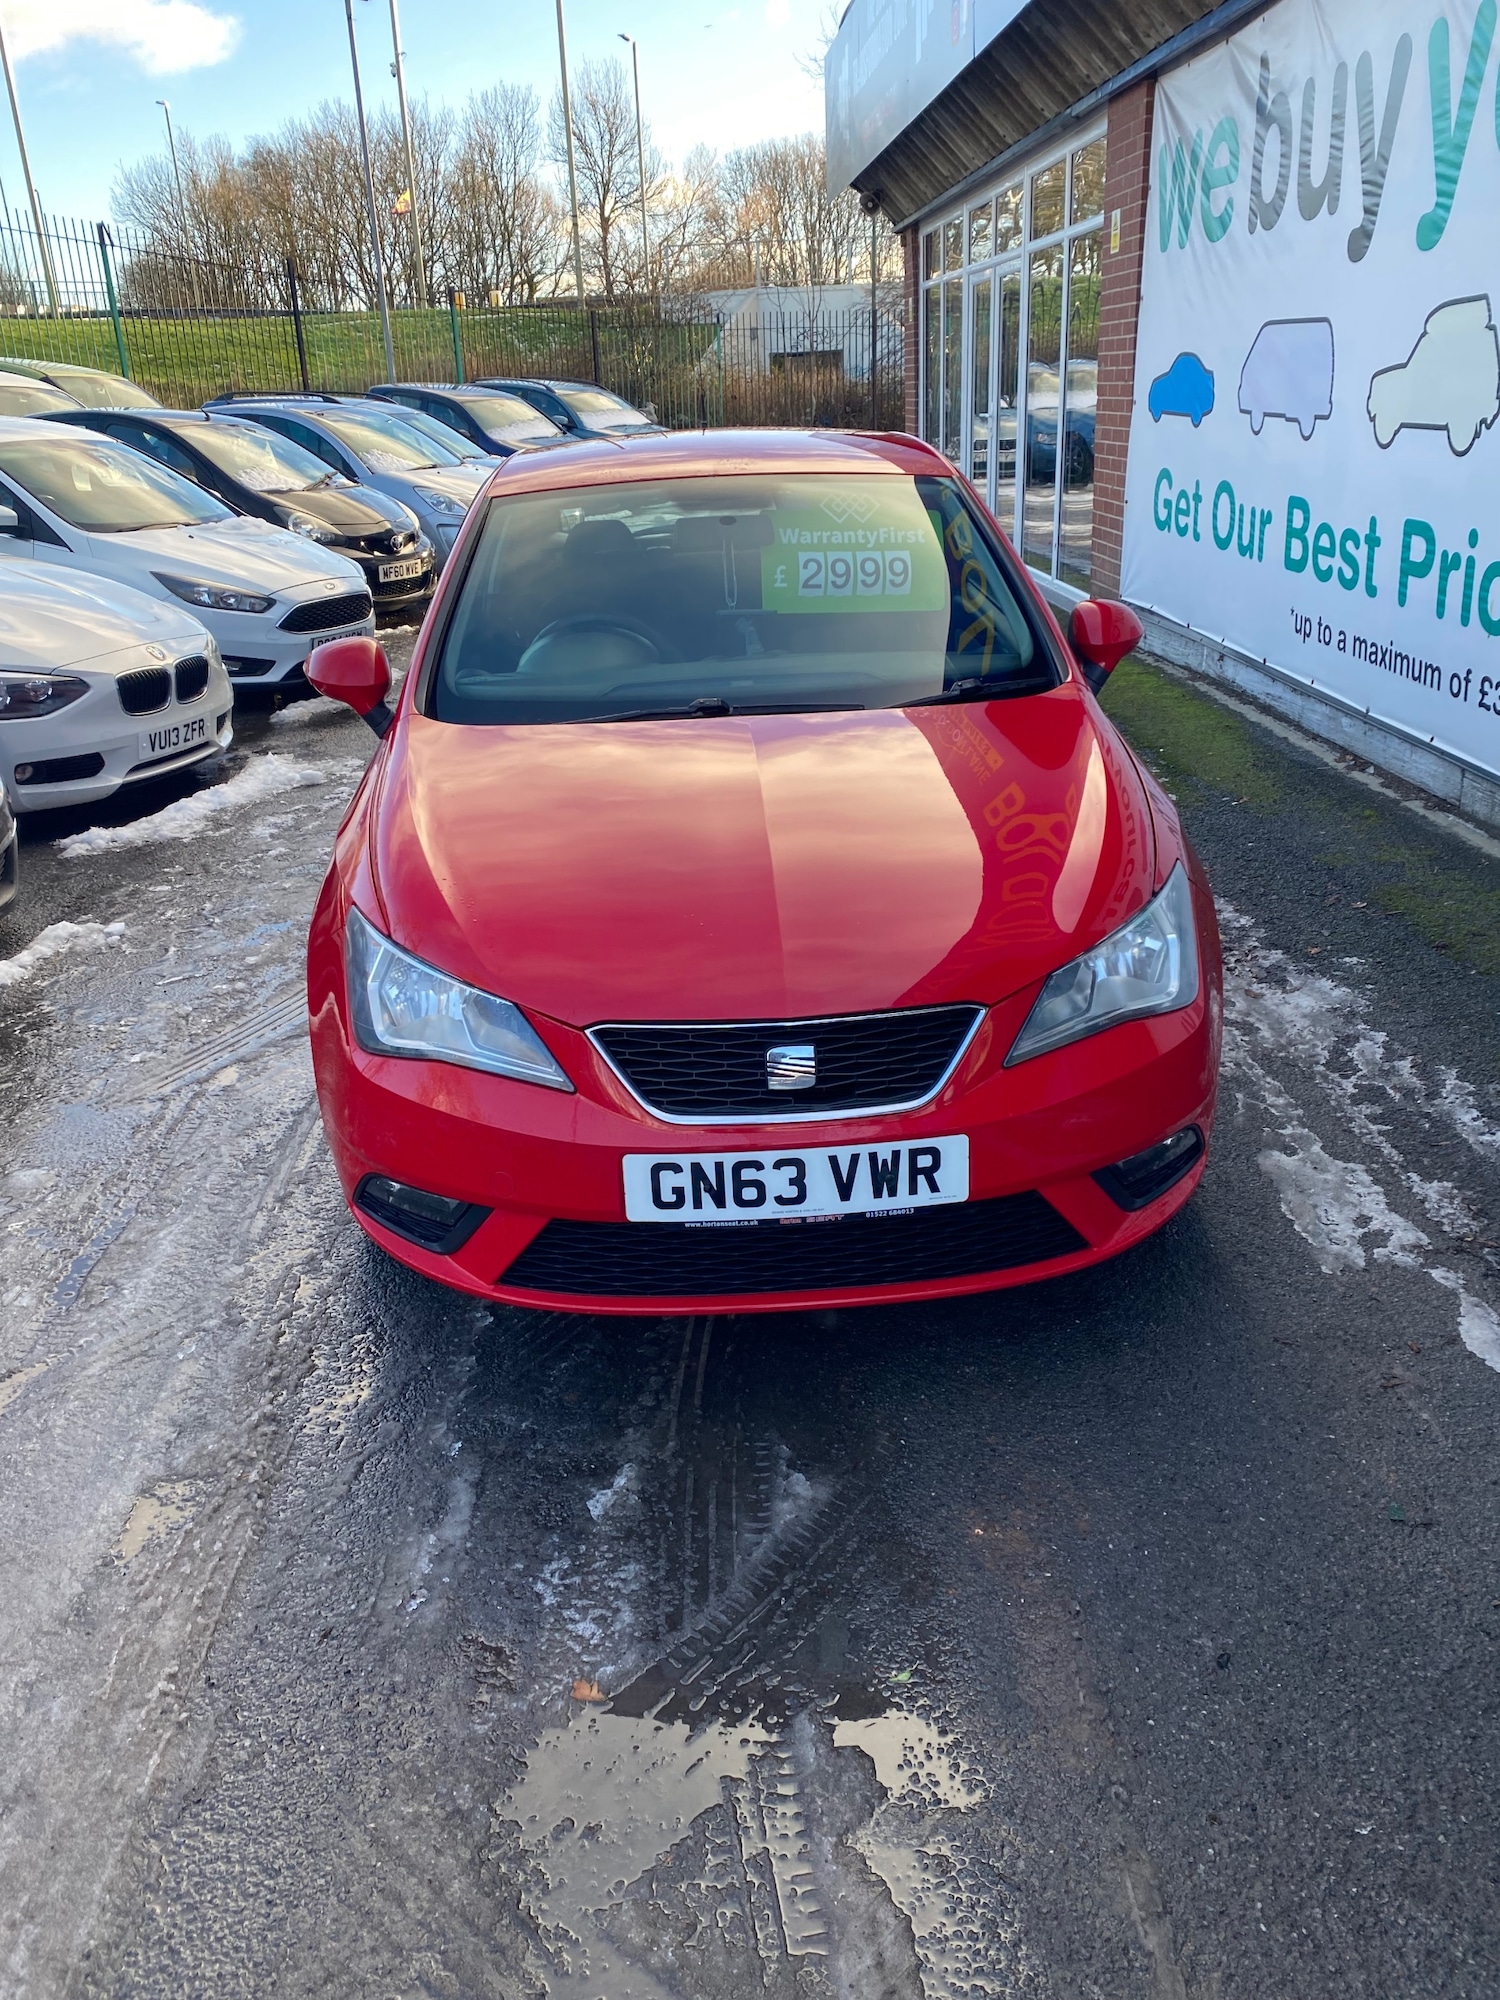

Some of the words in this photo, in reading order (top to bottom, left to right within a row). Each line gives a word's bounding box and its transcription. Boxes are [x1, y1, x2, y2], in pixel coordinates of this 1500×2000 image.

[778, 527, 926, 548] WarrantyFirst
[1153, 467, 1202, 542] Get
[1212, 480, 1272, 562] Our
[1284, 495, 1381, 599] Best
[801, 557, 910, 589] 2999
[1317, 617, 1332, 649] to
[1337, 629, 1347, 652] a
[1352, 635, 1441, 691] maximum
[1449, 668, 1472, 702] of
[149, 727, 180, 752] VU13
[183, 718, 205, 743] ZFR
[650, 1157, 808, 1211] GN63
[827, 1146, 942, 1203] VWR
[685, 1219, 759, 1228] www.hortonseat.co.uk
[865, 1210, 888, 1218] 01522
